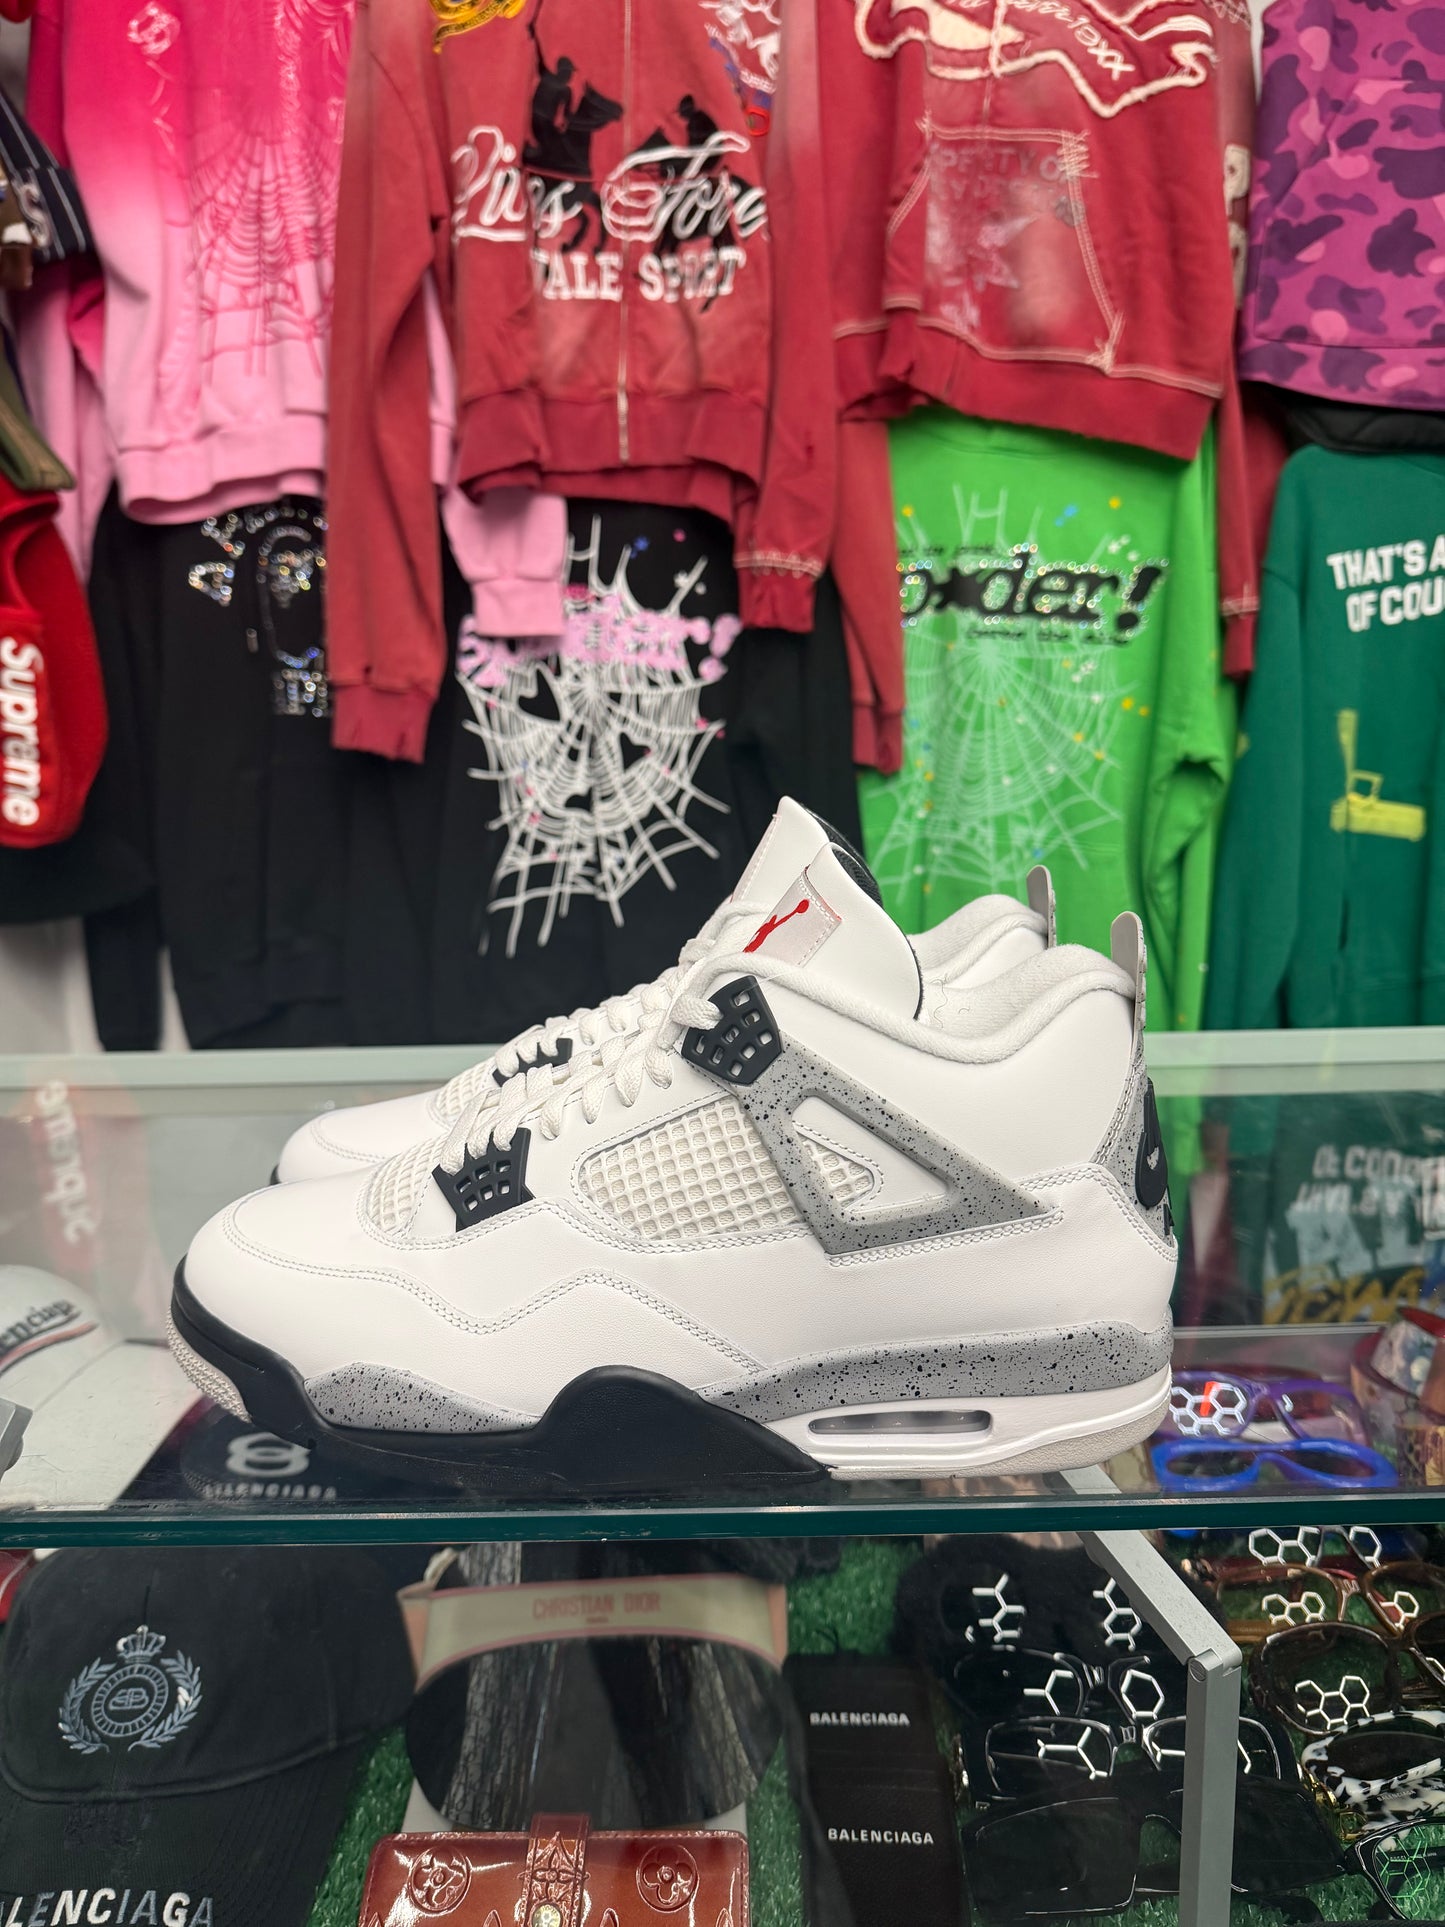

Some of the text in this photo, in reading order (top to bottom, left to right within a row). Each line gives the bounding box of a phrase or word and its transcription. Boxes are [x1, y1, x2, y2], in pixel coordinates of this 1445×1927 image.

[1326, 539, 1427, 590] THAT'S
[1346, 575, 1445, 633] OF COU
[809, 1711, 911, 1727] BALENCIAGA
[827, 1827, 935, 1845] BALENCIAGA
[0, 1887, 214, 1927] LENCIAGA
